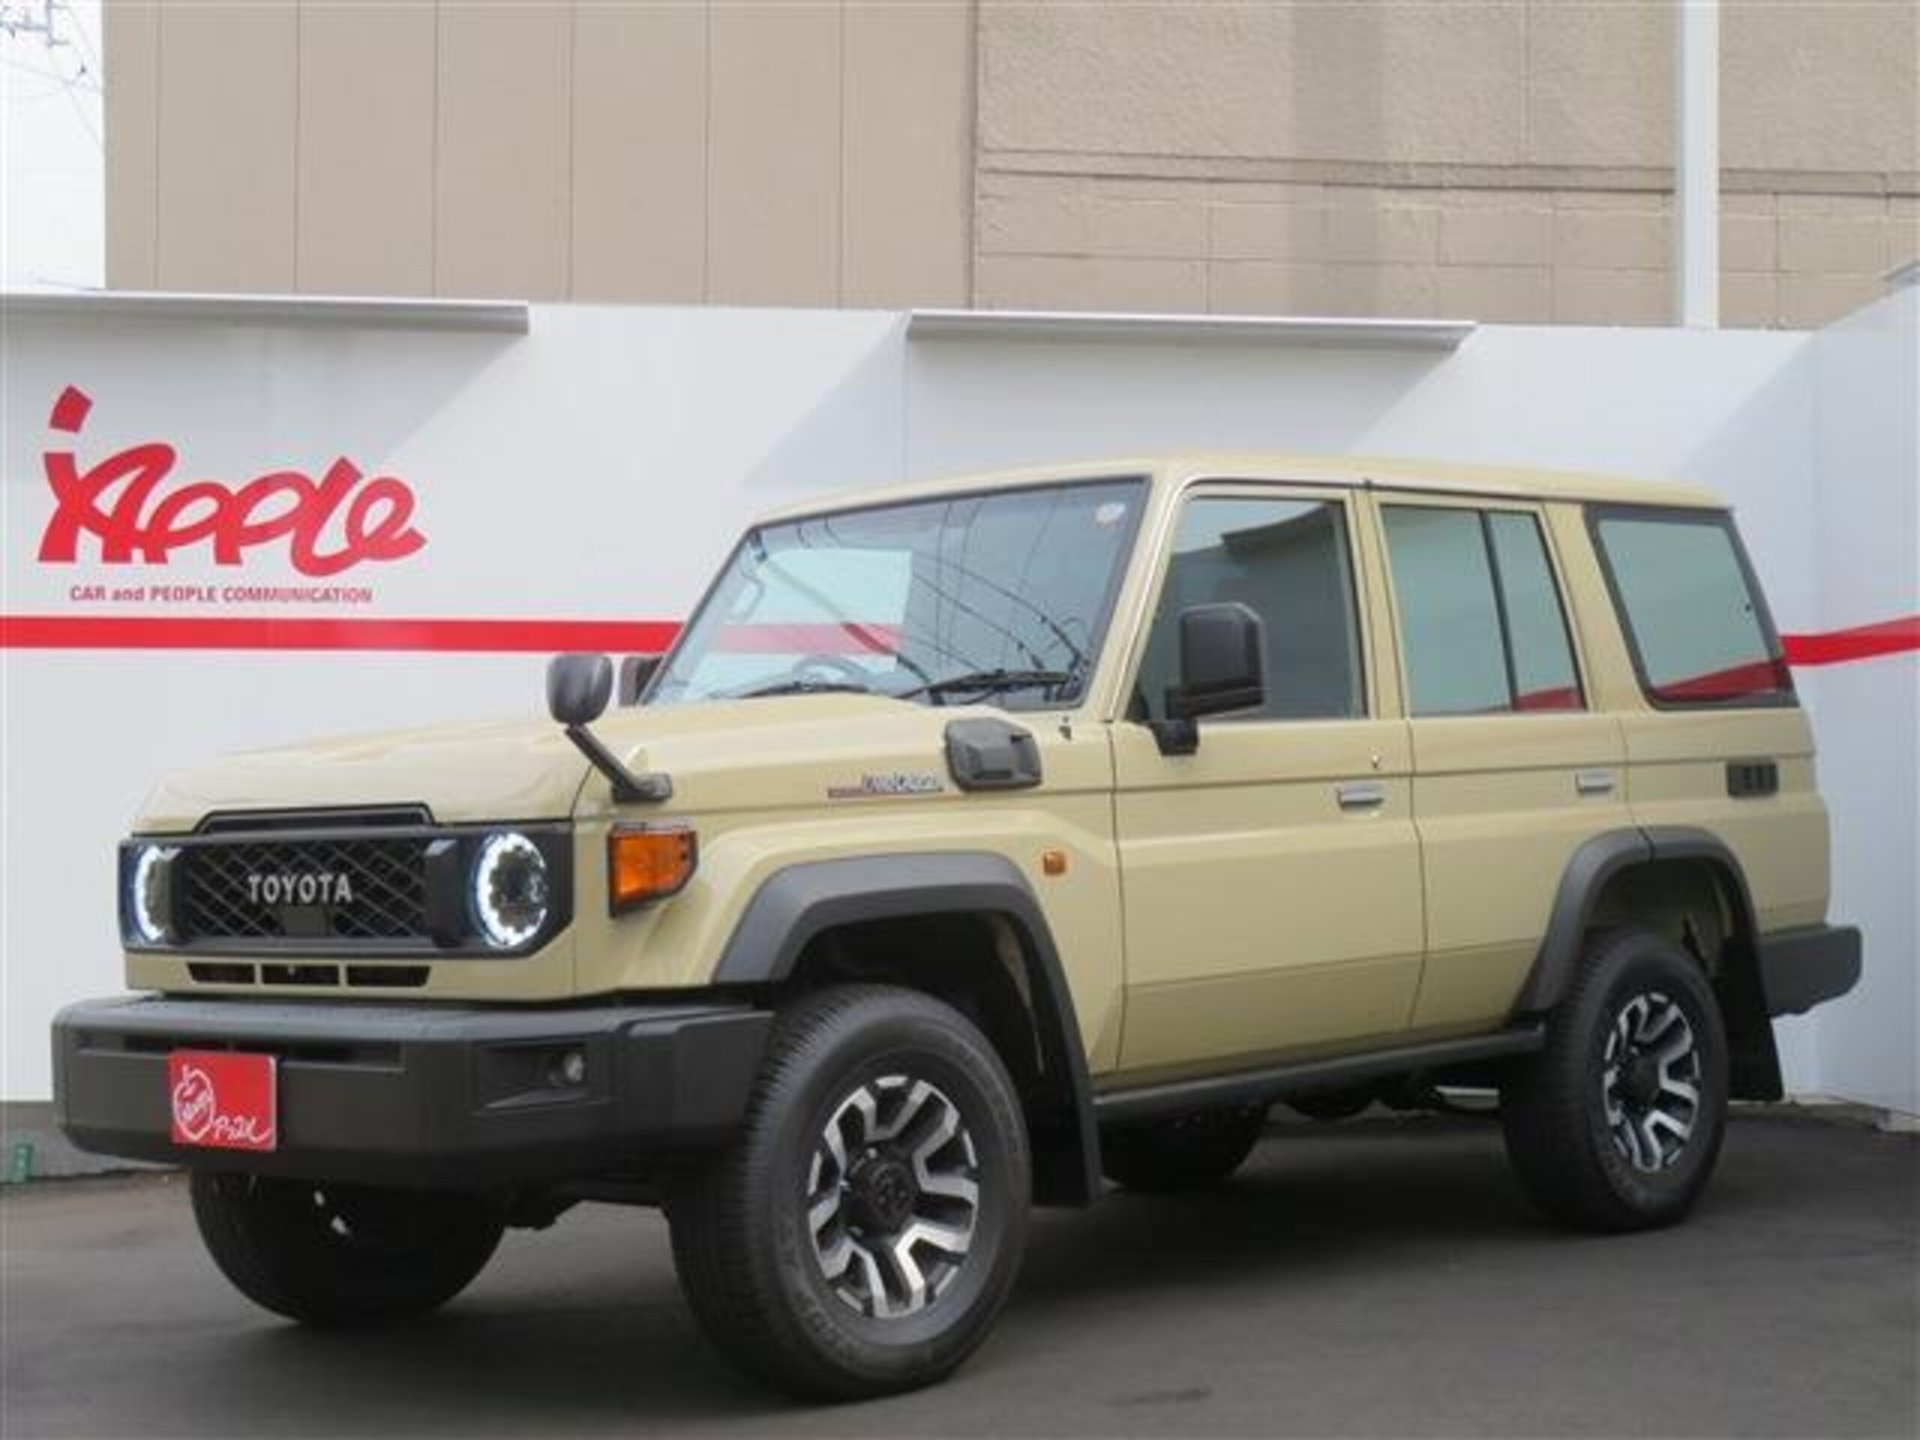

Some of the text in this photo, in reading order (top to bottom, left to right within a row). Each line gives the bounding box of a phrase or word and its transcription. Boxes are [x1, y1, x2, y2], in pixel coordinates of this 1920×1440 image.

[70, 585, 373, 604] CAR and PEOPLE COMMUNICATION
[248, 873, 352, 904] TOYOTA
